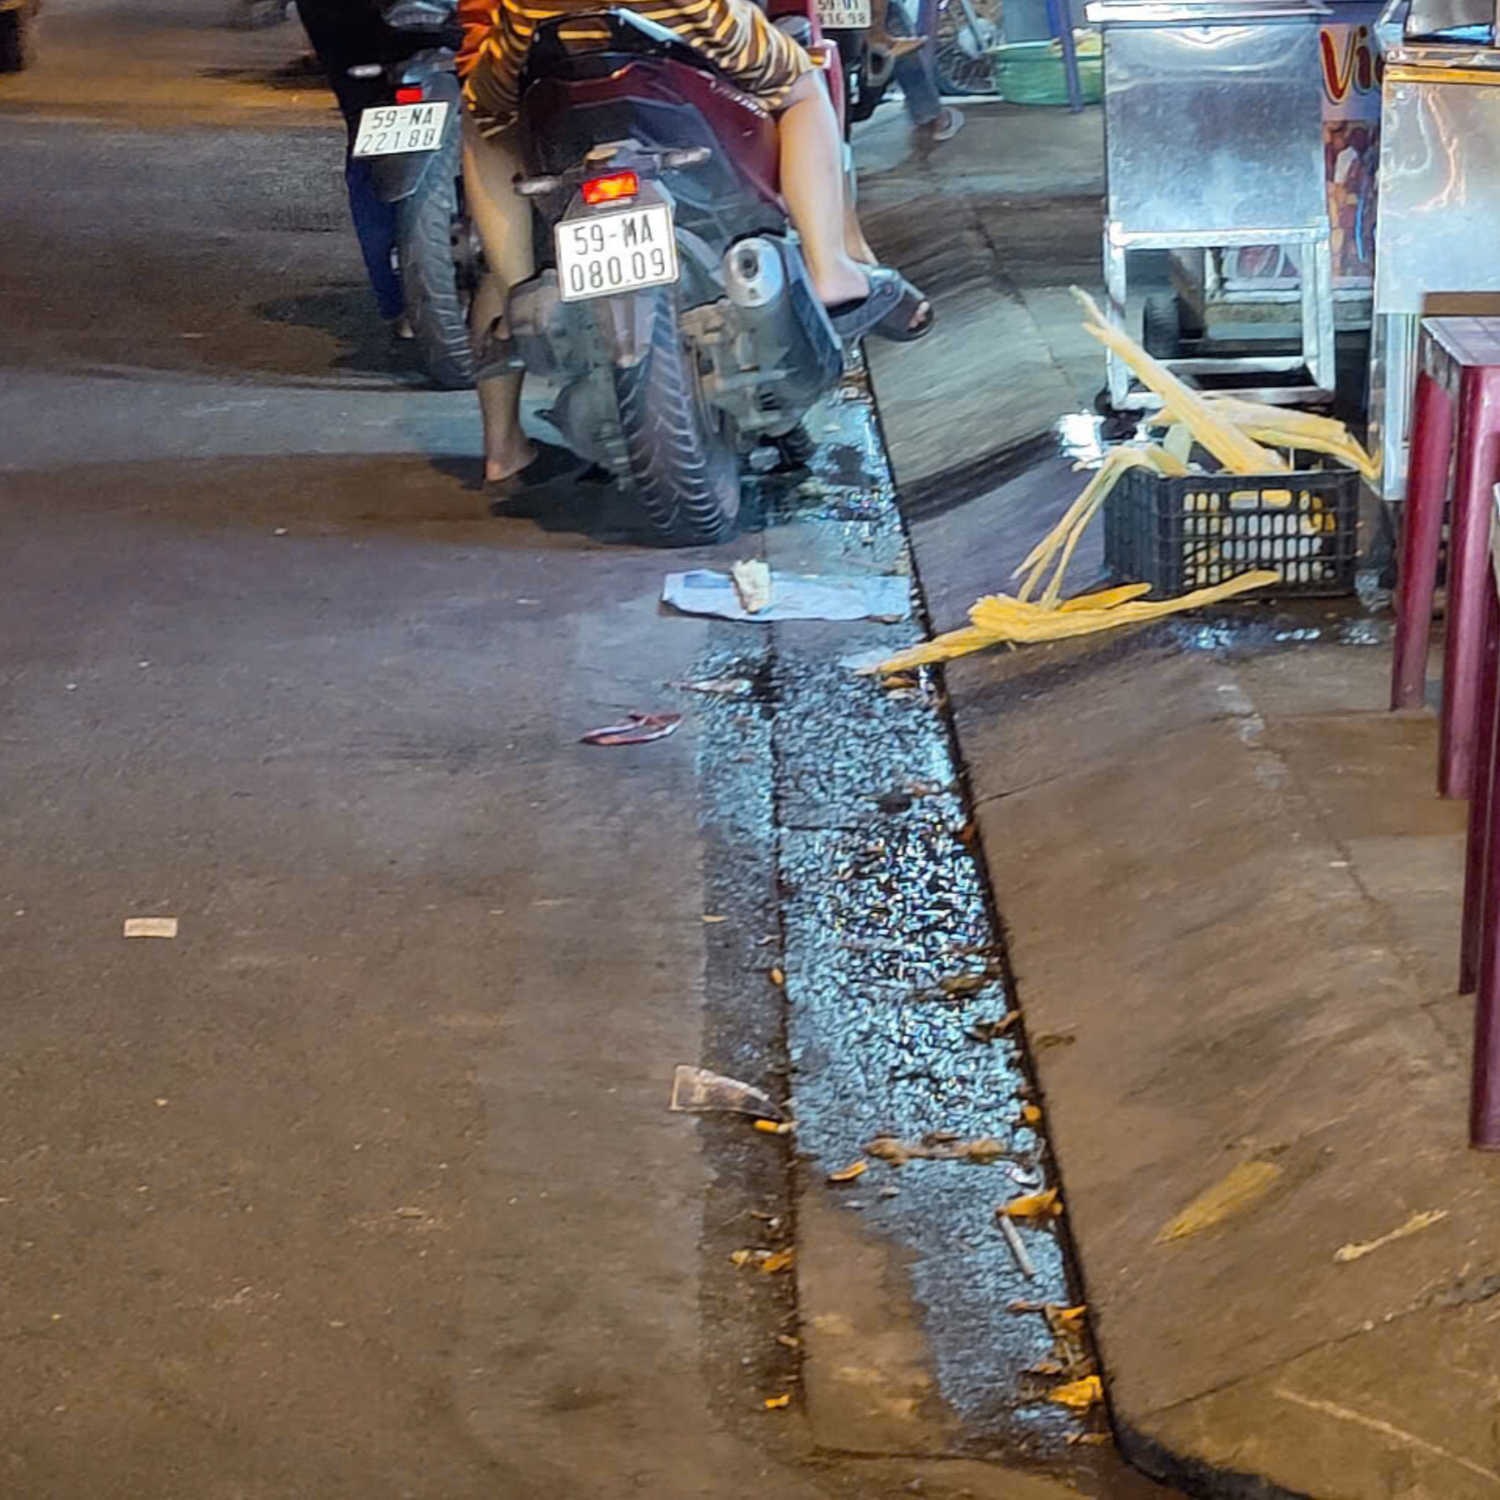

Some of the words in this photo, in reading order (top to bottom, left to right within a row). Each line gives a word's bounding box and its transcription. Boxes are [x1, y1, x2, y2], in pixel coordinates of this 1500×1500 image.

[371, 106, 435, 130] 59-NA
[572, 213, 655, 256] 59-MA
[569, 247, 666, 293] 080.09
